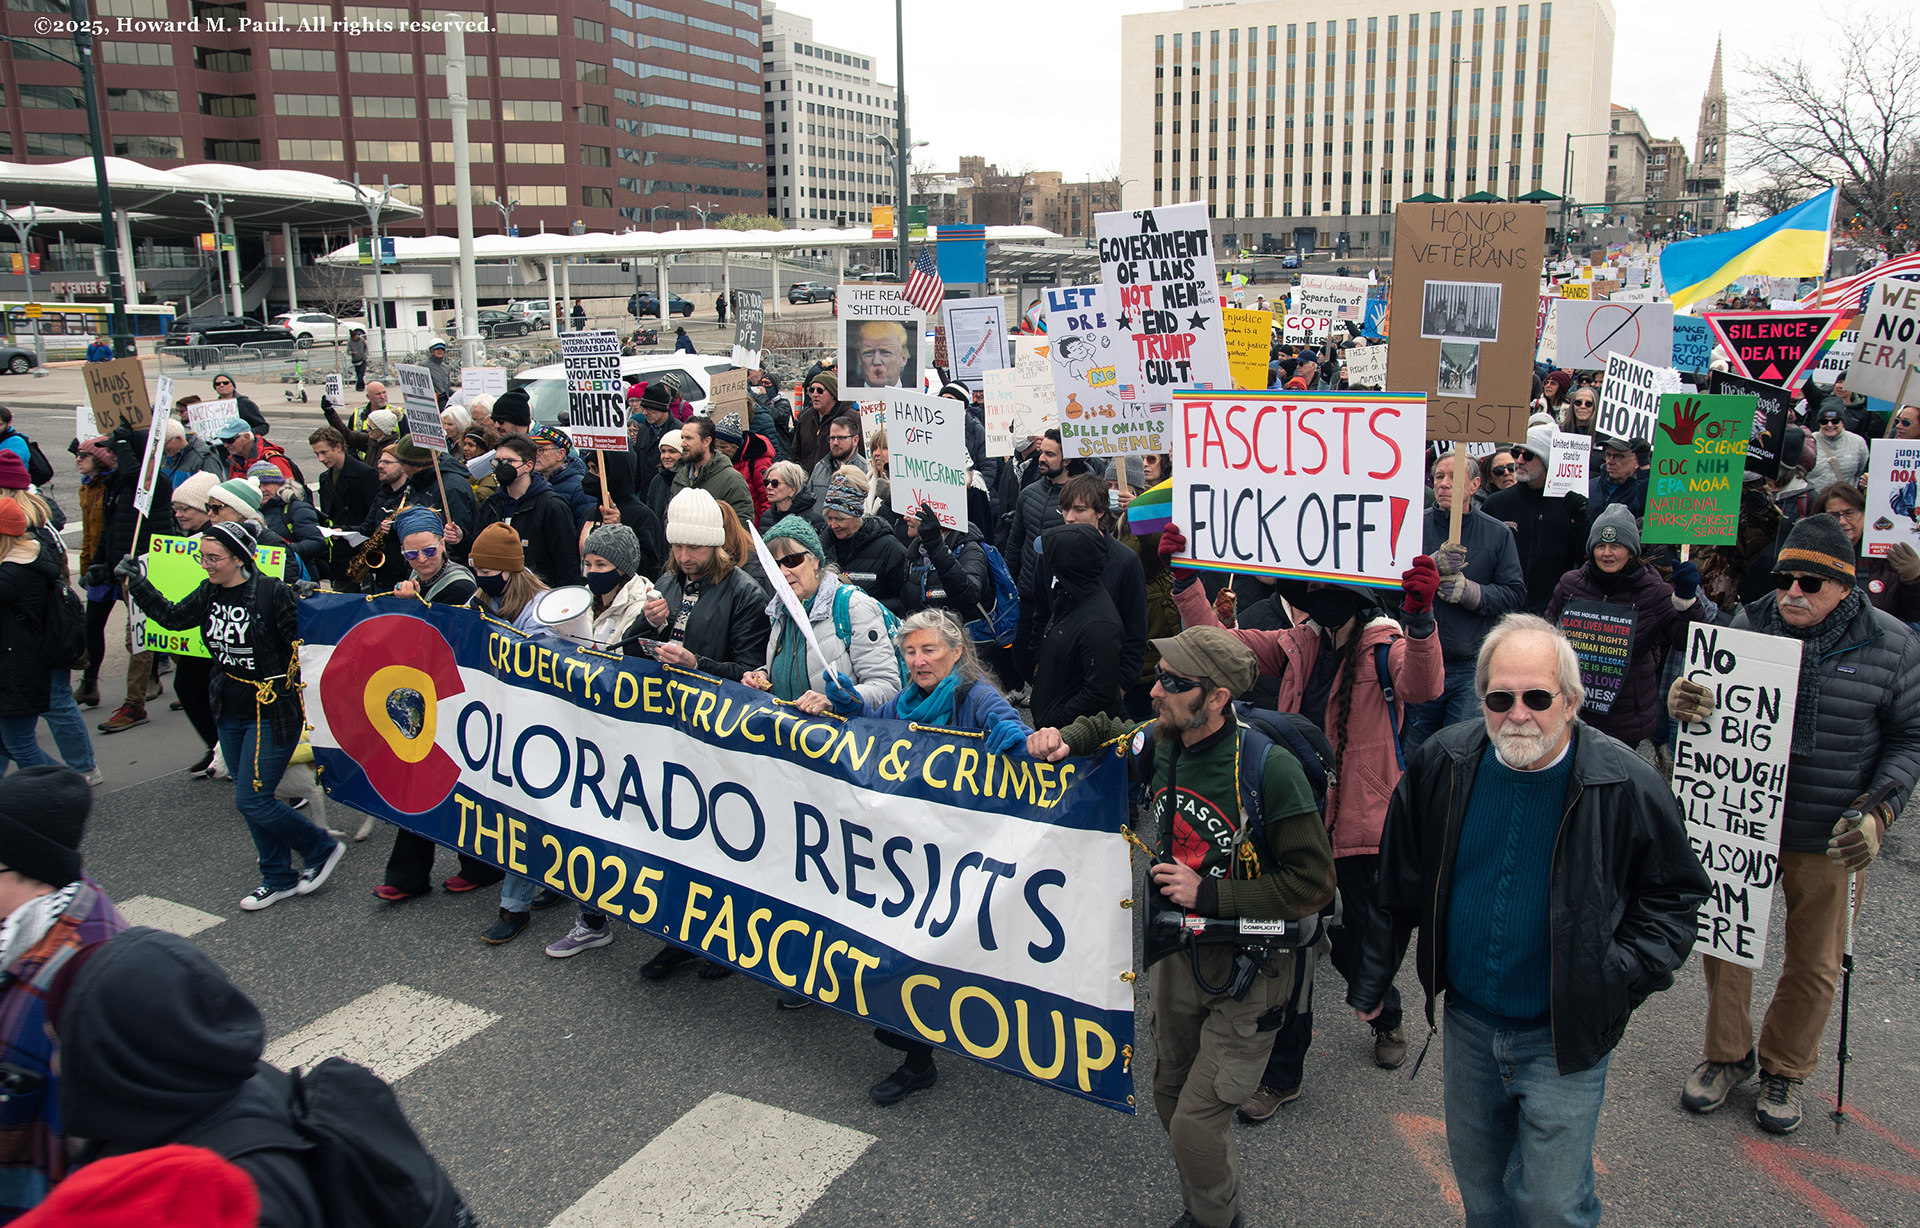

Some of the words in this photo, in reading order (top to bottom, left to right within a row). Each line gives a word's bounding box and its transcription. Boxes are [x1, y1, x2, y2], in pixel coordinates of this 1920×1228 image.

[1430, 208, 1517, 234] HONOR
[1098, 229, 1208, 263] GOVERNMENT
[1452, 231, 1495, 250] OUR
[1411, 243, 1527, 269] VETERANS
[1117, 262, 1139, 284] OF
[1150, 258, 1195, 281] LAWS
[1302, 276, 1322, 289] Defend
[1561, 285, 1588, 298] HANDS
[737, 291, 749, 307] FIX
[852, 290, 875, 300] THE
[880, 290, 902, 300] REA
[1120, 279, 1153, 308] NOT
[1301, 290, 1347, 304] Separation
[1350, 295, 1362, 305] of
[739, 309, 763, 323] HEARTS
[1300, 303, 1333, 316] Powers
[1142, 310, 1178, 335] END
[1287, 317, 1329, 330] GOP
[1729, 323, 1807, 339] SILENCE
[562, 337, 618, 346] INTERNATIONAL
[599, 344, 618, 352] DAY
[1132, 333, 1196, 361] TRUMP
[1673, 344, 1708, 353] STOP
[1686, 335, 1708, 344] UP!
[564, 356, 620, 369] DEFEND
[1371, 355, 1377, 363] A
[1741, 346, 1800, 360] DEATH
[90, 369, 131, 395] HANDS
[399, 369, 431, 390] VICTORY
[566, 369, 620, 380] WOMEN'S
[1145, 359, 1190, 386] CULT
[1608, 357, 1653, 389] BRING
[568, 381, 576, 391] &
[578, 380, 621, 391] LGBTQ
[711, 380, 746, 396] OUTRAGE
[112, 390, 134, 406] OFF
[97, 409, 115, 429] US
[188, 402, 216, 421] NAZIS
[569, 392, 624, 428] RIGHTS
[894, 402, 945, 425] HANDS
[1426, 400, 1524, 437] ESIST
[410, 421, 444, 438] RESISTANCE
[1599, 400, 1656, 445] HOM
[1706, 420, 1742, 439] OFF
[1183, 402, 1402, 480] FASCISTS
[1694, 437, 1749, 455] SCIENCE
[1747, 444, 1774, 459] ENOUGH
[893, 453, 966, 486] IMMIGRANTS
[1556, 463, 1583, 478] JUSTICE
[1659, 459, 1688, 475] CDC
[1696, 459, 1729, 474] NIH
[1890, 469, 1917, 482] YOU
[1657, 477, 1686, 495] EPA
[1689, 476, 1730, 492] NOAA
[912, 488, 949, 511] Veteran
[1649, 497, 1721, 511] NATIONAL
[1190, 484, 1288, 563] FUCK
[1693, 526, 1735, 537] SERVICE
[153, 538, 197, 555] STOP
[1562, 617, 1582, 629] BLACK
[1583, 621, 1602, 631] LIVES
[1603, 624, 1630, 636] MATTER
[147, 632, 190, 652] MUSK
[1572, 641, 1598, 652] HUMAN
[1600, 645, 1628, 657] RIGHTS
[1597, 635, 1628, 646] RIGHTS
[1690, 628, 1737, 675] NO
[1591, 663, 1600, 671] IS
[1602, 665, 1623, 676] REAL
[1598, 656, 1626, 667] ILLEGAL
[1595, 675, 1621, 690] LOVE
[489, 632, 605, 706] CRUELTY,
[614, 671, 876, 772] DESTRUCTION
[878, 738, 912, 782] &
[922, 744, 1076, 809] CRIMES
[1721, 715, 1772, 752] BIG
[1676, 741, 1786, 792] ENOUGH
[1674, 774, 1716, 800] TO
[1721, 784, 1783, 819] LIST
[1718, 807, 1768, 841] THE
[1690, 836, 1778, 889] EASONS
[793, 800, 1067, 963] RESISTS
[454, 793, 528, 875] THE
[542, 833, 665, 924] 2025
[679, 881, 881, 1017] FASCIST
[900, 973, 1117, 1092] COUP
[1696, 913, 1756, 960] ERE
